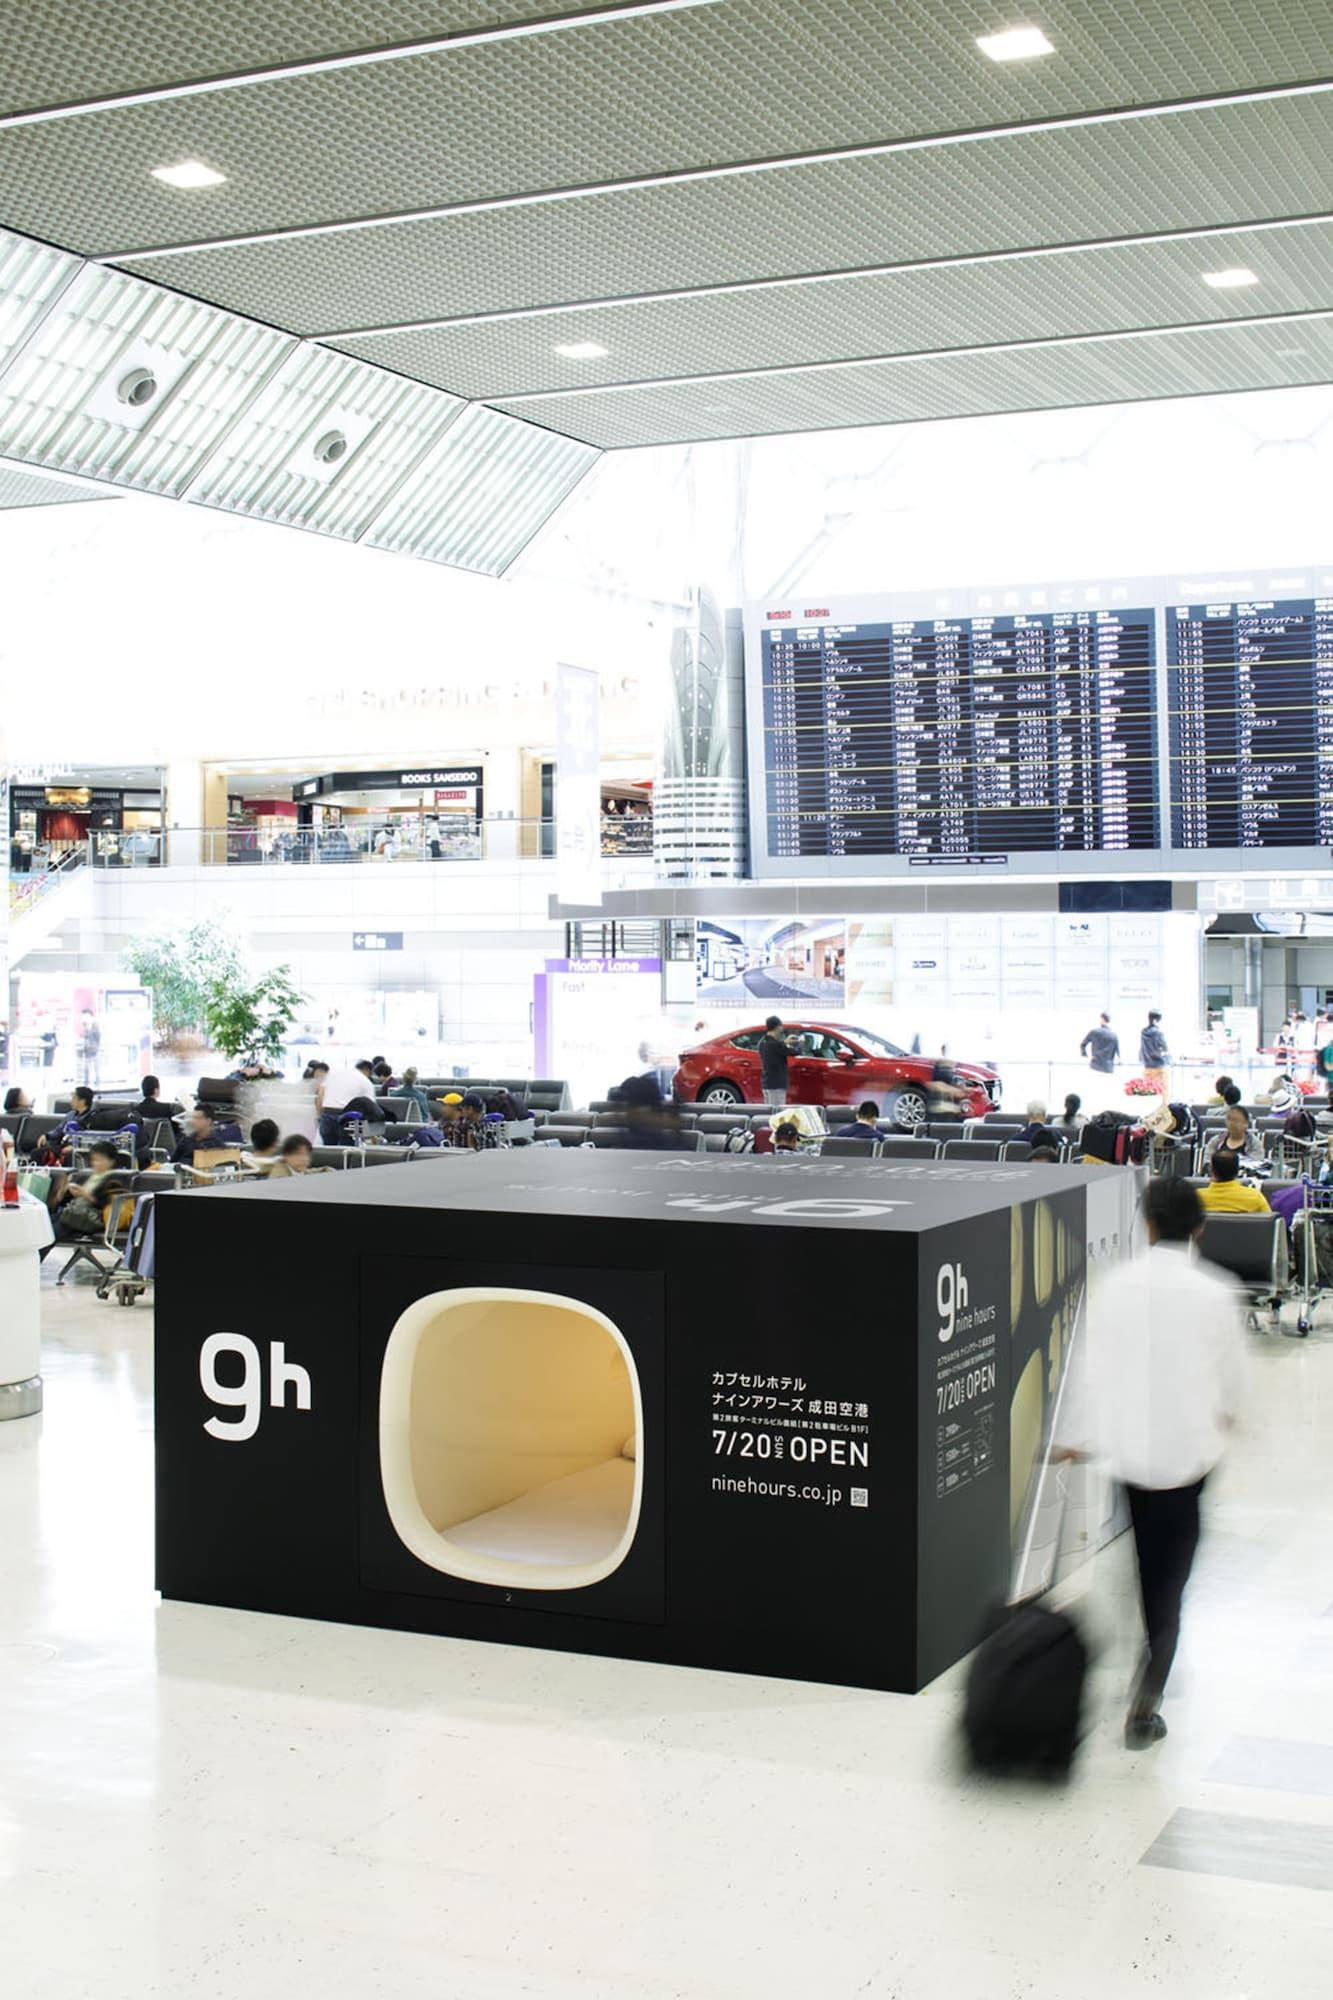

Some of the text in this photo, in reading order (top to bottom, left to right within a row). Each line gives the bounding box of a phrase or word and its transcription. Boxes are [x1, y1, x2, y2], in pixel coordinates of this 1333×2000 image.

[401, 772, 477, 784] BOOKS SANSEIDO
[608, 959, 640, 973] Lane
[664, 1198, 915, 1218] 9h
[937, 1262, 968, 1343] 9h
[955, 1304, 996, 1334] nine hours
[199, 1332, 312, 1442] 9h
[712, 1371, 807, 1391] カプセルホテル
[937, 1379, 961, 1415] 7/20
[966, 1362, 996, 1400] OPEN
[712, 1393, 869, 1418] ナインアワーズ 成田空港
[712, 1430, 869, 1468] 7/20 SUN OPEN
[712, 1474, 842, 1506] ninehours.co.jp
